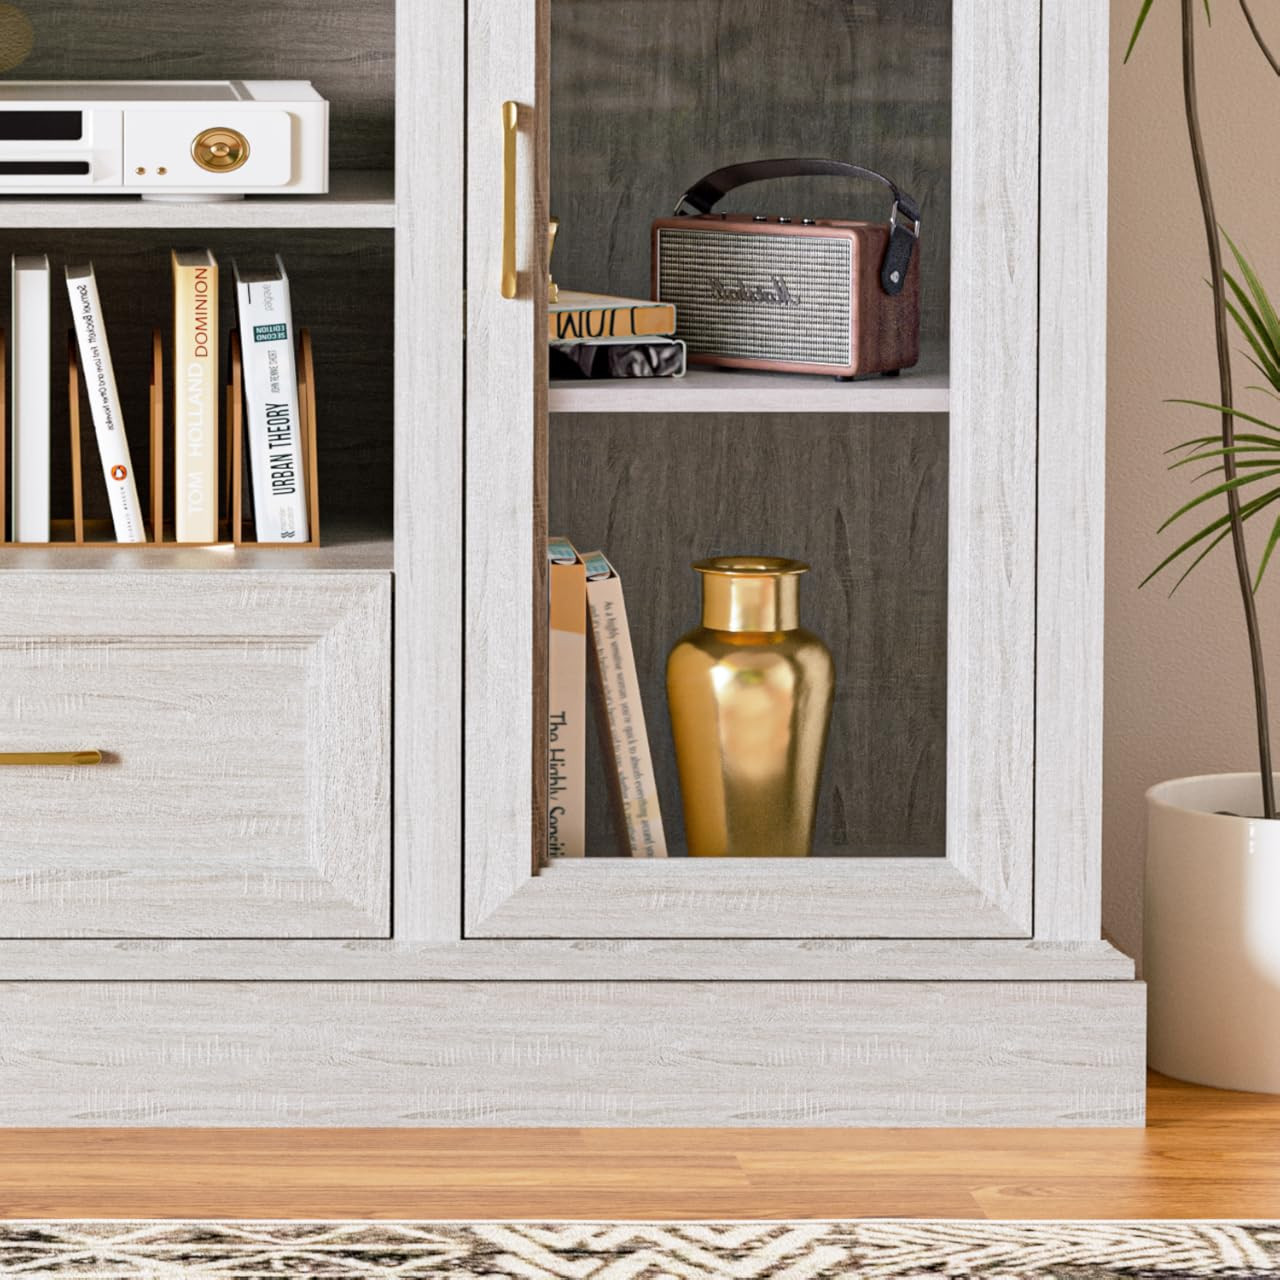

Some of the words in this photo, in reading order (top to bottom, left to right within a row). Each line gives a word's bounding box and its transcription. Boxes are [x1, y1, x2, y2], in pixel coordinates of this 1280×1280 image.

[194, 267, 208, 357] DOMINION
[256, 325, 285, 333] EDITION
[256, 332, 285, 340] SECOND
[187, 363, 203, 457] HOLLAND
[265, 403, 292, 450] THEORY
[188, 472, 203, 513] TOM
[271, 452, 296, 496] URBAN
